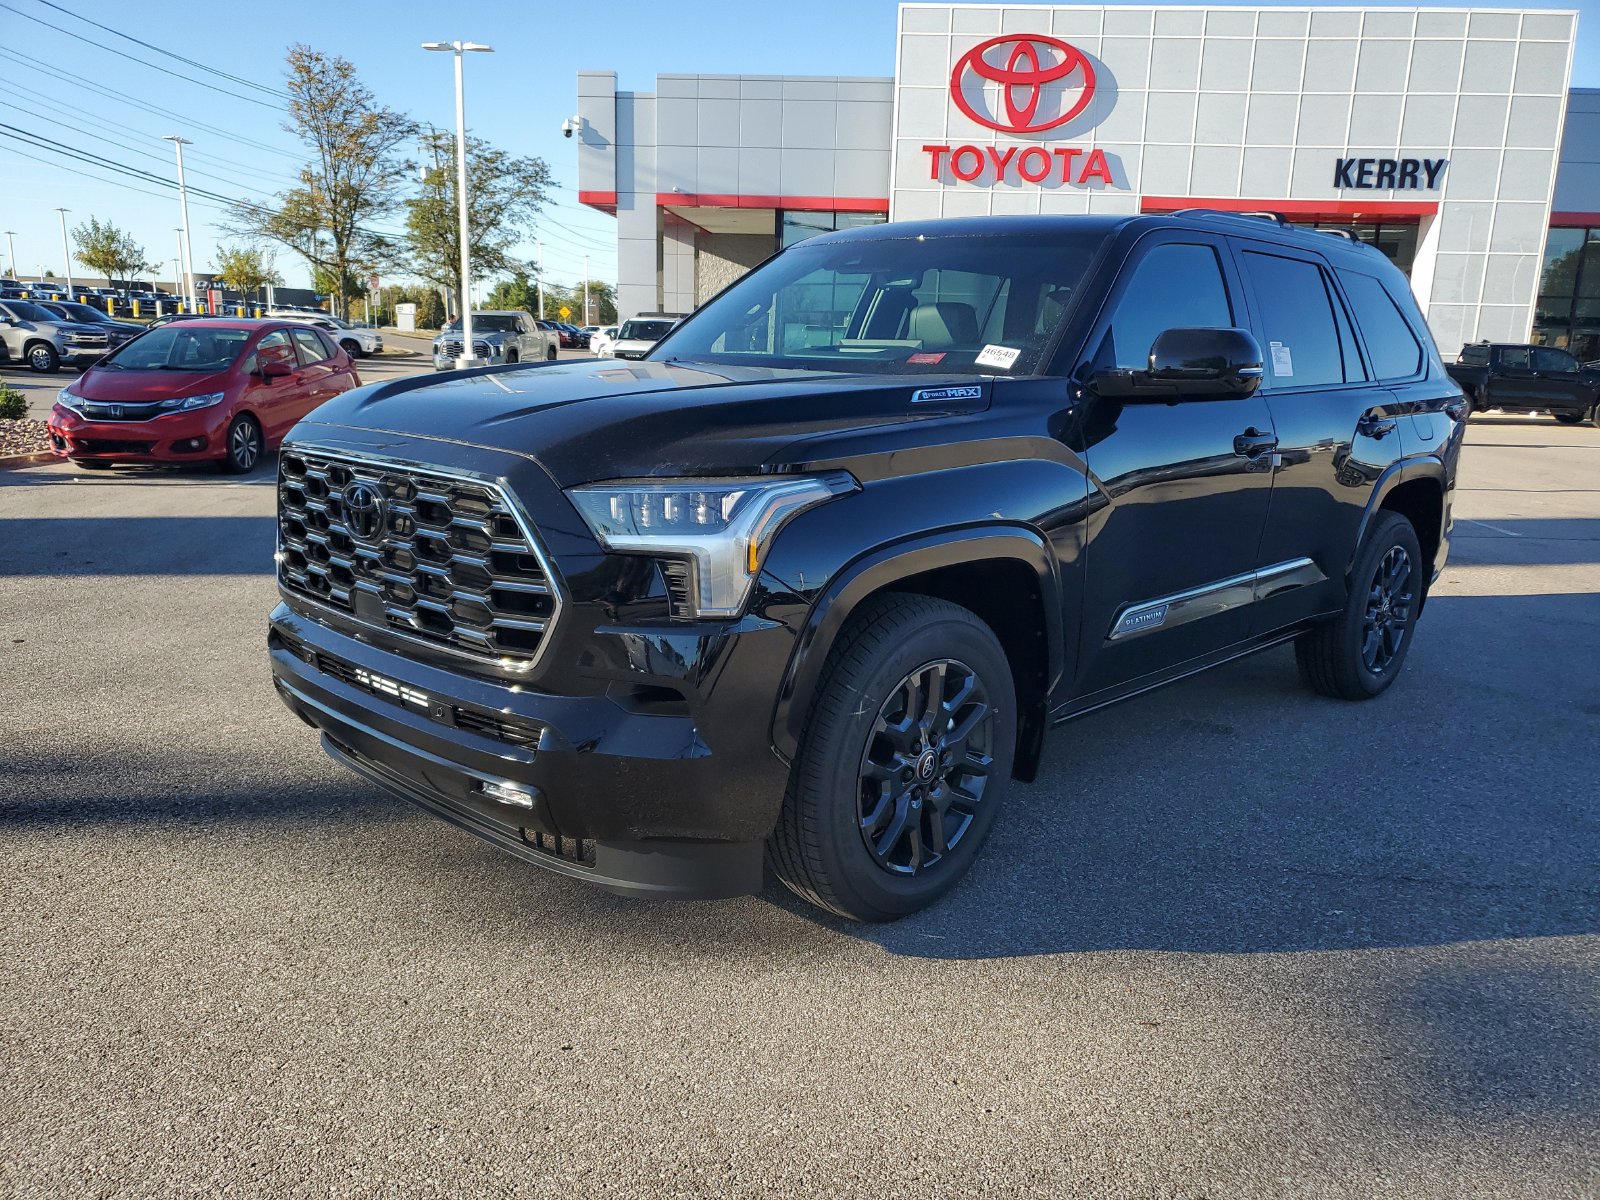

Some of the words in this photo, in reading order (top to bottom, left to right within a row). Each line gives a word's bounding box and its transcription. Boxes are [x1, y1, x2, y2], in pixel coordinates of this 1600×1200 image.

[922, 144, 1113, 184] TOYOTA
[1333, 158, 1446, 189] KERRY
[984, 348, 1016, 359] 46548
[946, 388, 978, 397] MAX
[1125, 611, 1162, 626] PLATINUM
